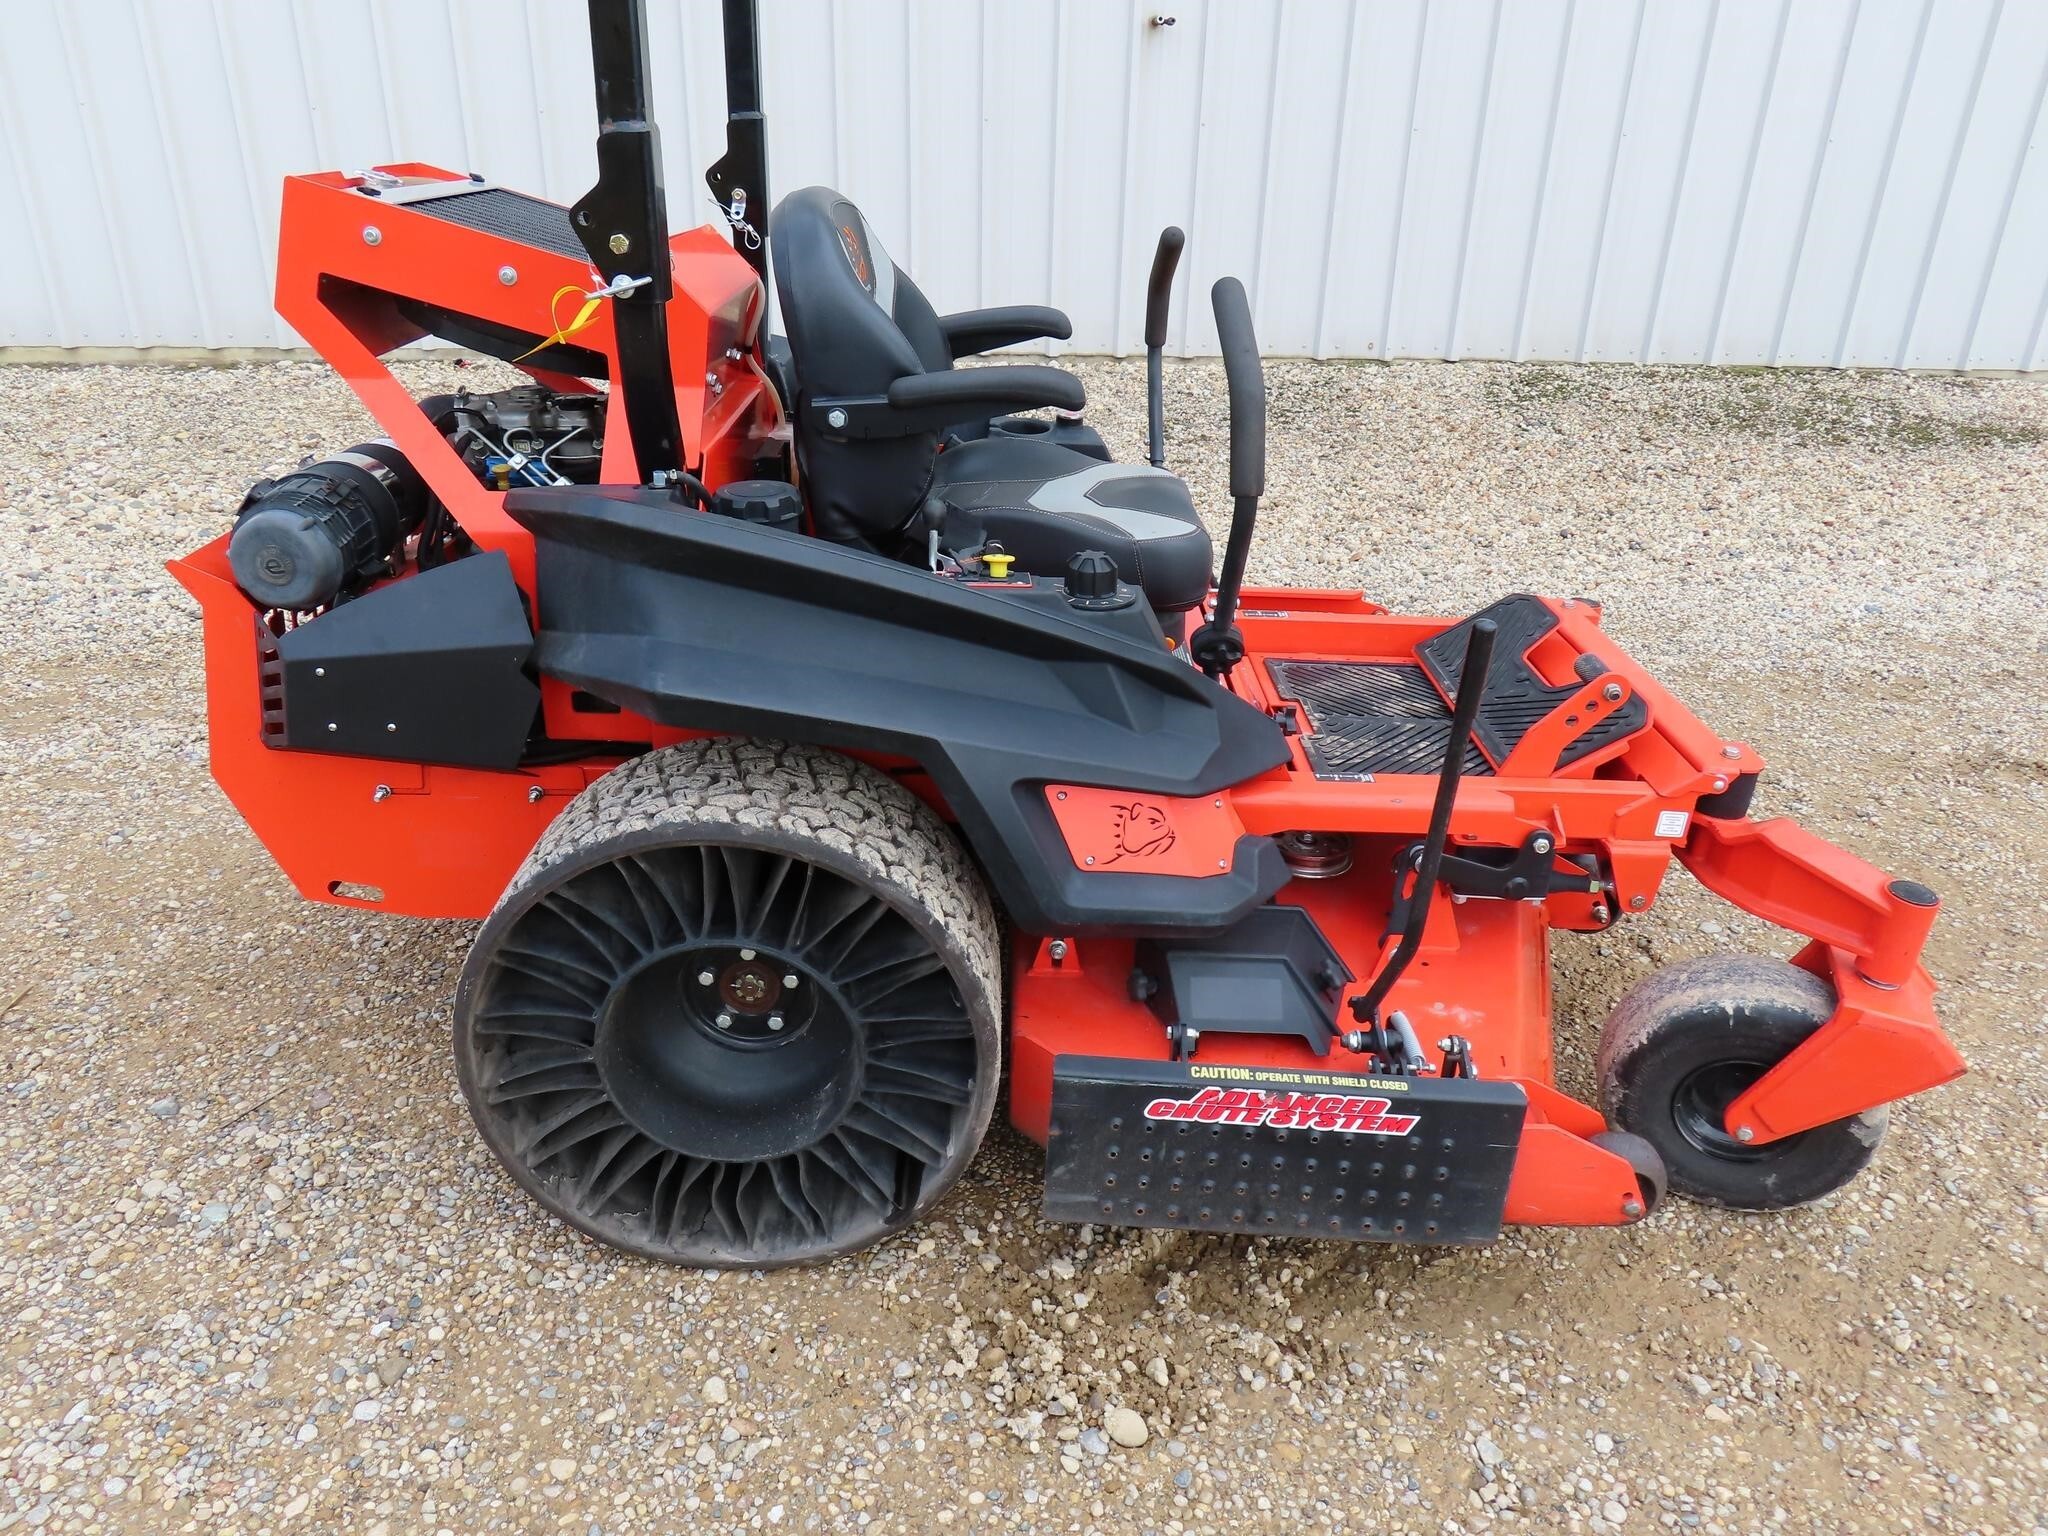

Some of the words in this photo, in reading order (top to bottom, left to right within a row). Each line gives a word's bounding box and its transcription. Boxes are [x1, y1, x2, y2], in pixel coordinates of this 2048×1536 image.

[1191, 1066, 1254, 1081] CAUTION:
[1255, 1071, 1301, 1083] OPERATE
[1303, 1075, 1330, 1085] WITH
[1332, 1077, 1368, 1088] SHIELD
[1369, 1079, 1408, 1091] CLOSED
[1146, 1101, 1262, 1124] CHUTE
[1269, 1108, 1415, 1135] SYSTEM
